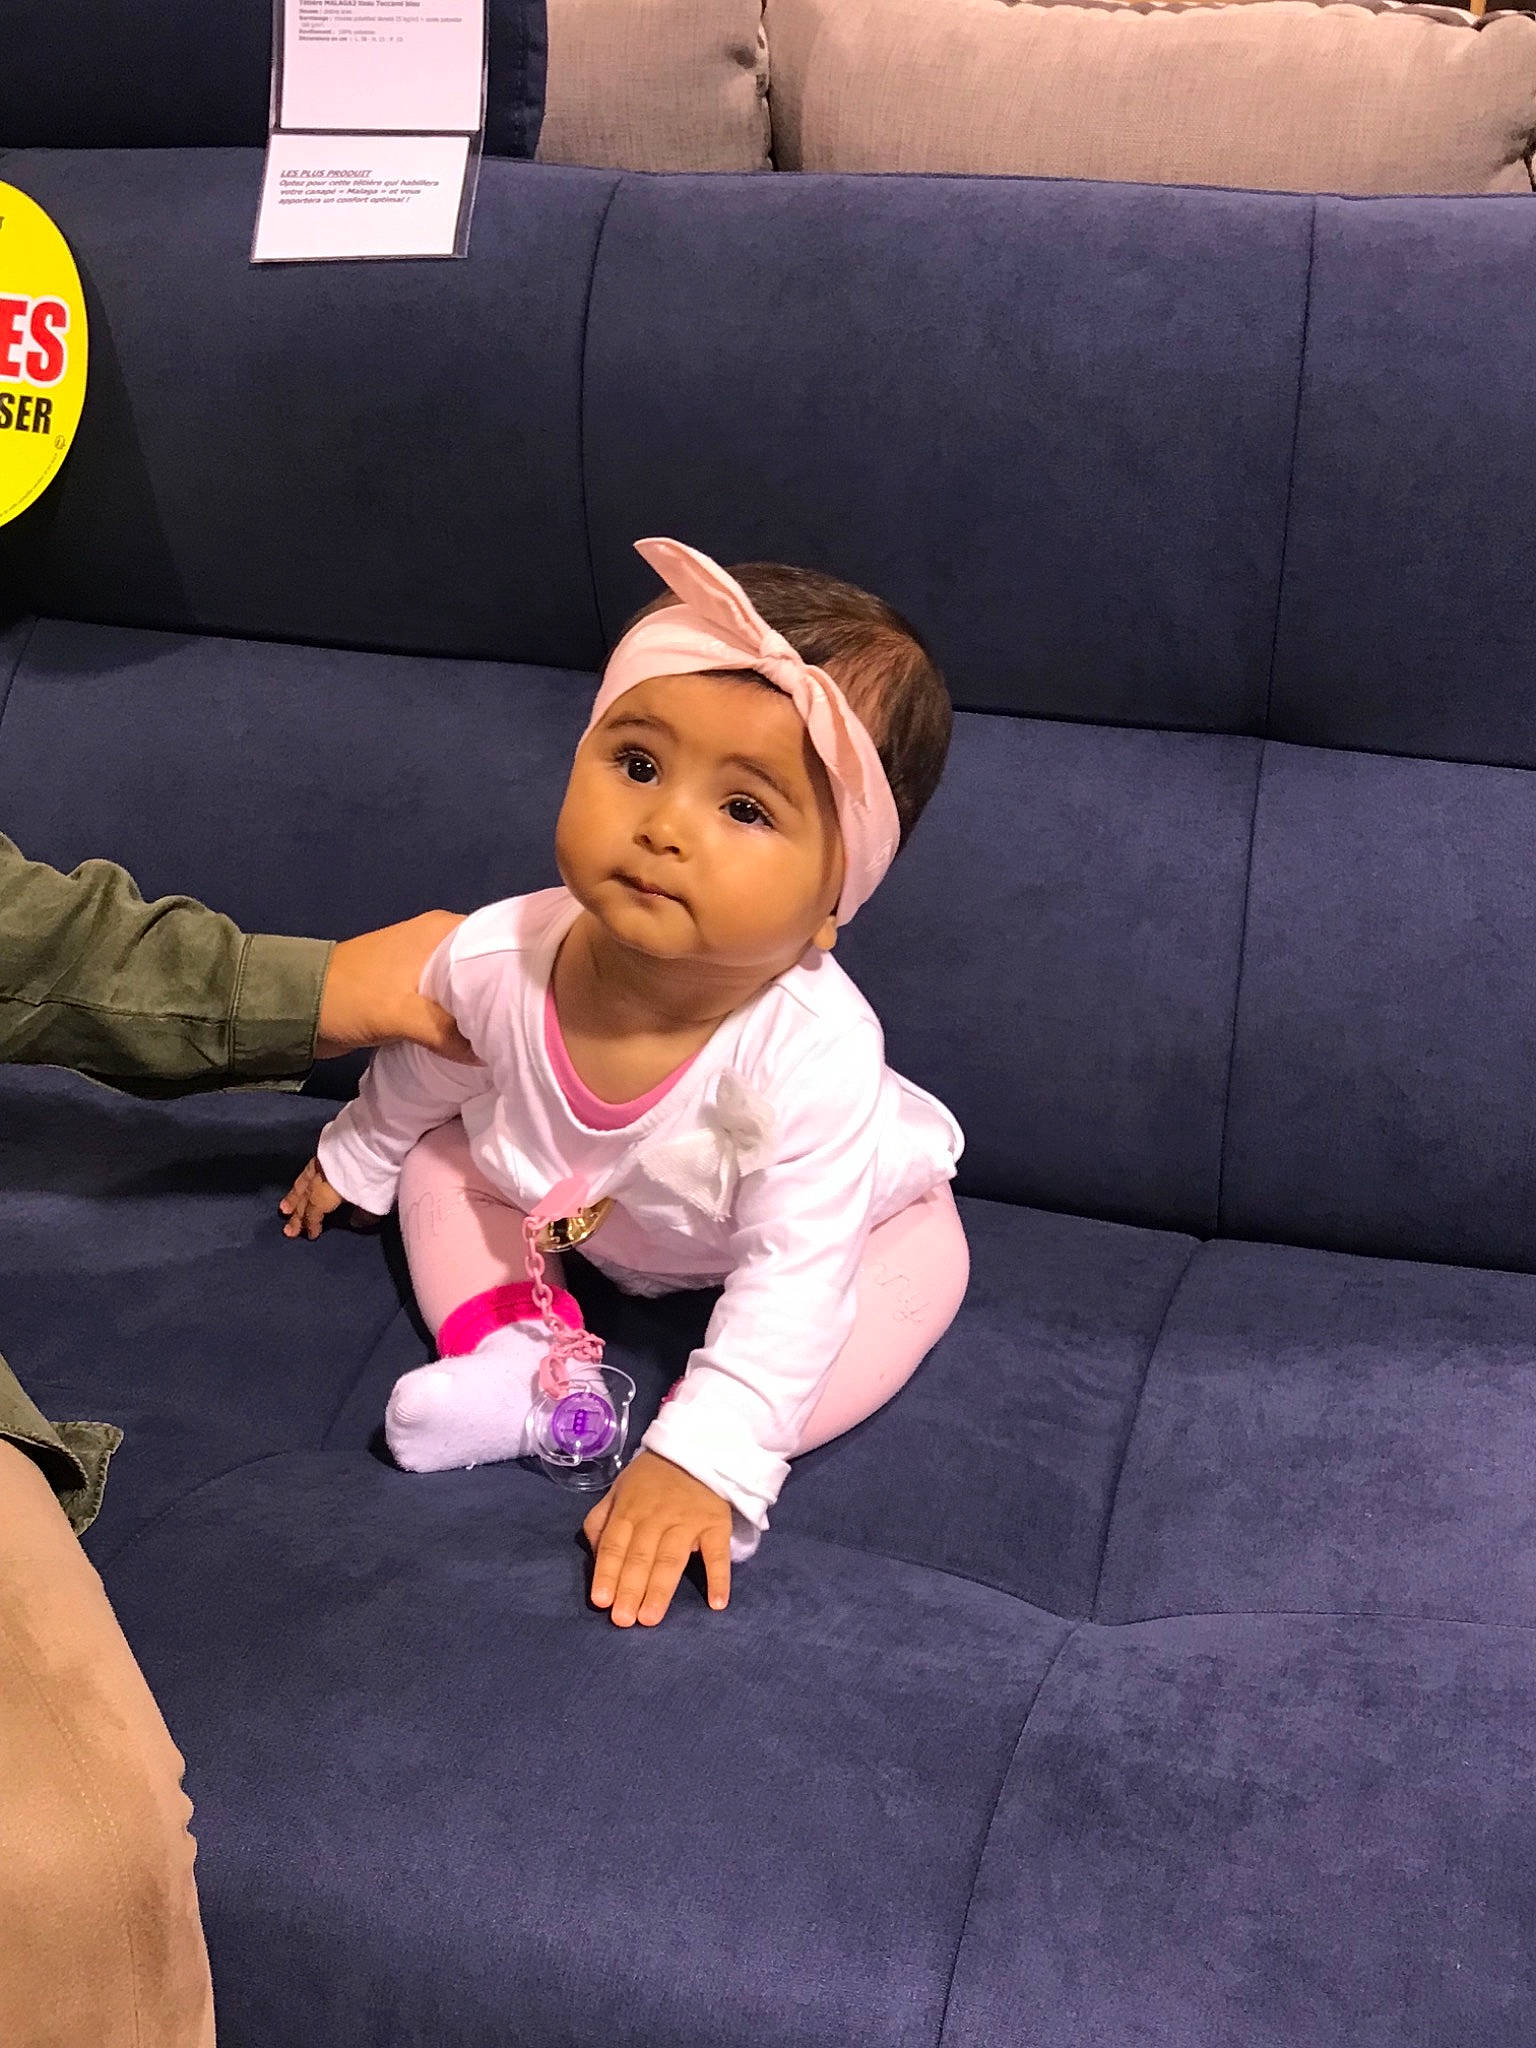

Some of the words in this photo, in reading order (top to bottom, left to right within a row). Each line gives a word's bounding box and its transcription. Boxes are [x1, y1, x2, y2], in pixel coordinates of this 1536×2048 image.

[280, 169, 299, 178] LES
[300, 169, 326, 178] PLUS
[327, 169, 373, 178] PRODUIT
[279, 179, 305, 187] Optez
[384, 179, 400, 187] qui
[0, 392, 53, 434] SER
